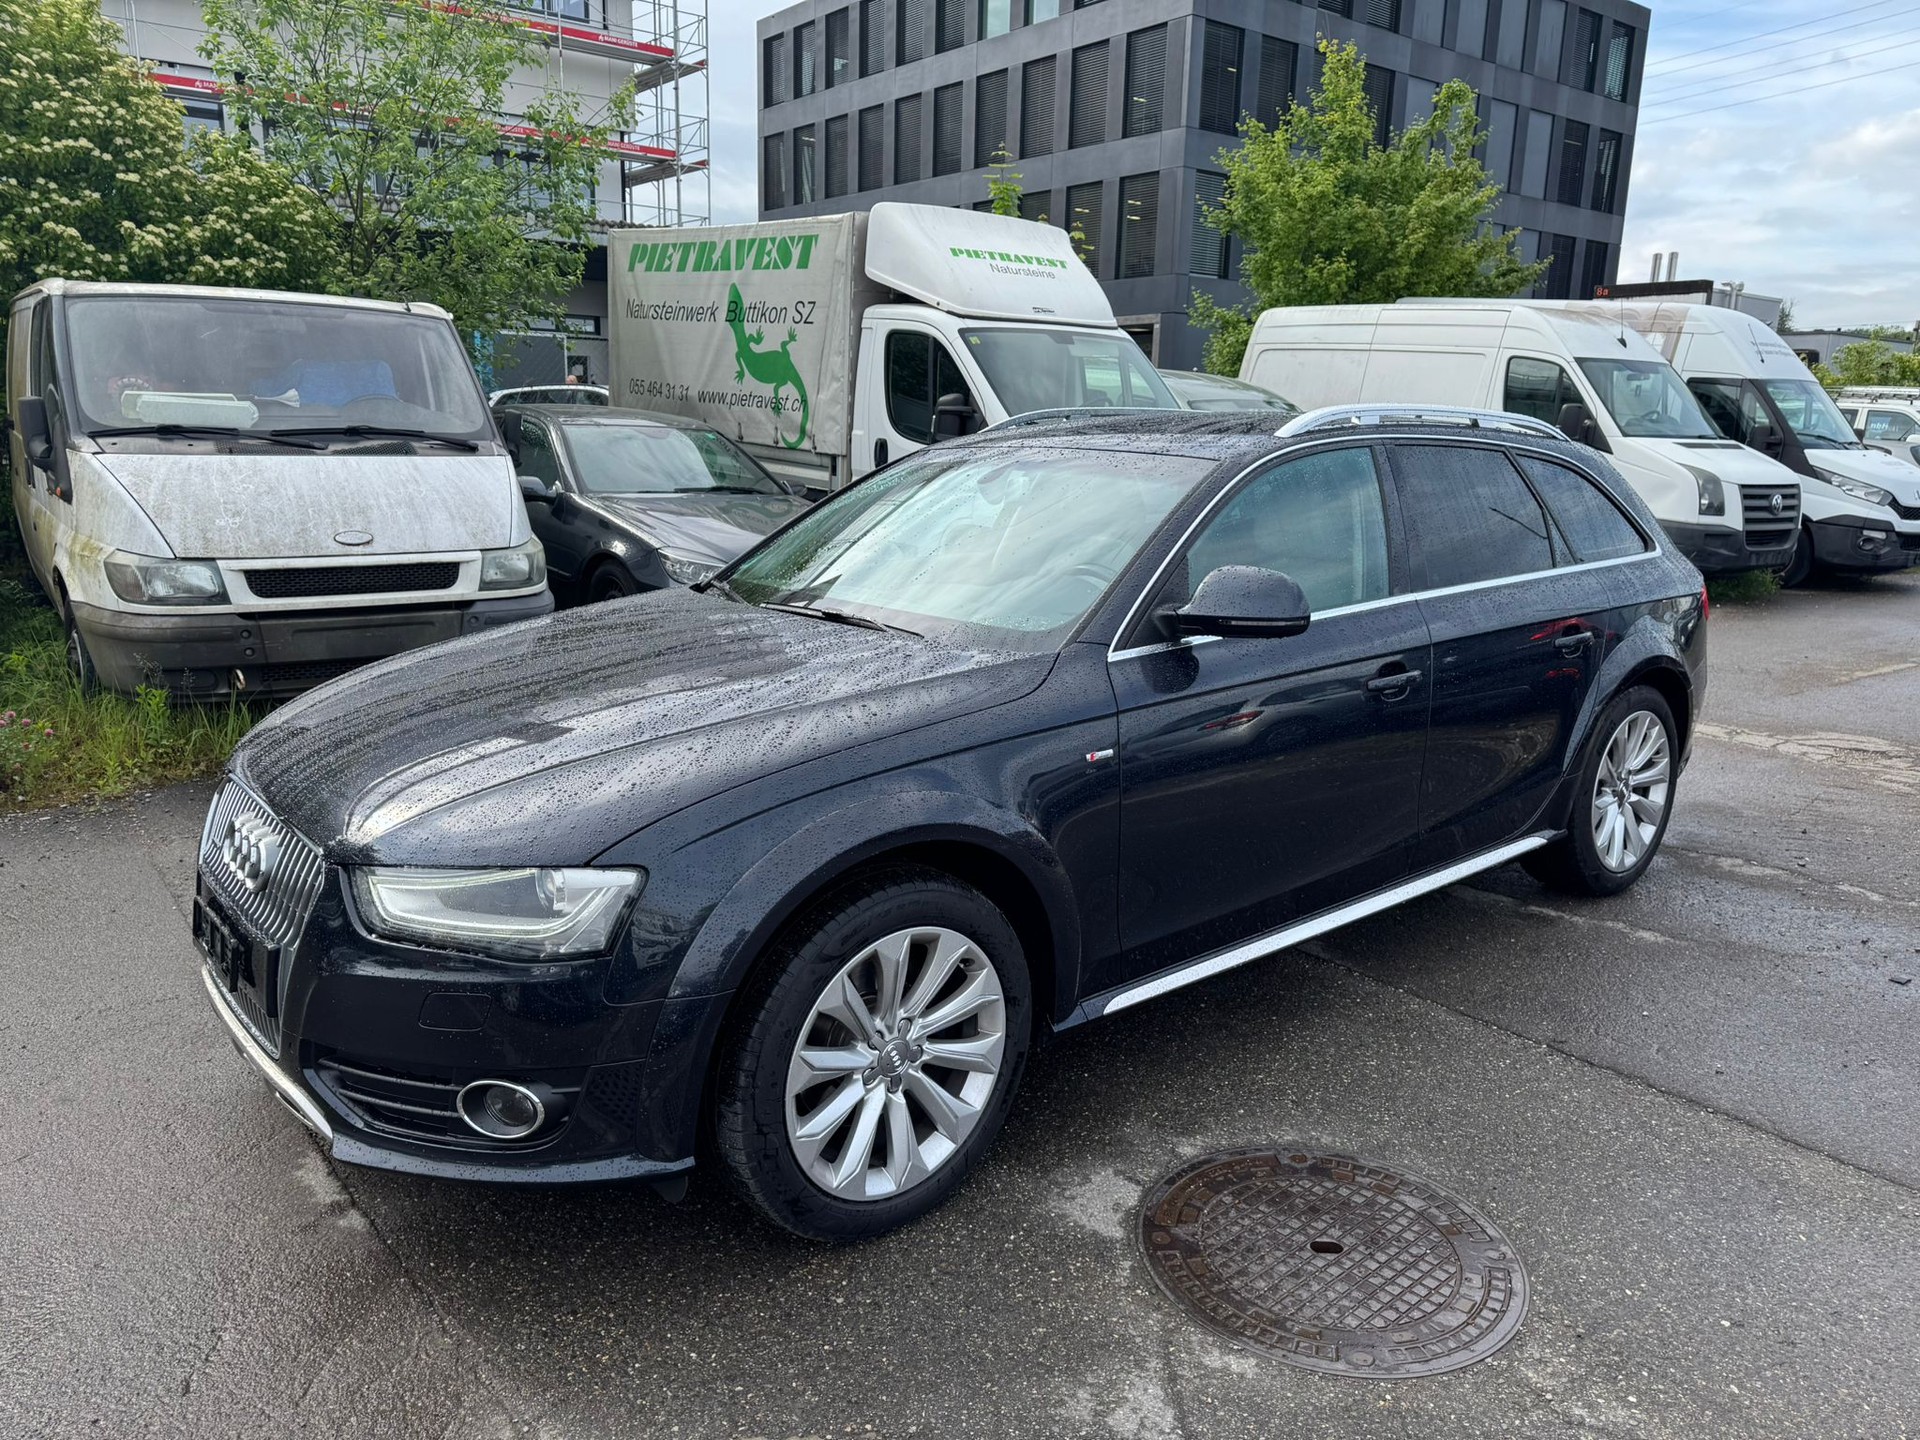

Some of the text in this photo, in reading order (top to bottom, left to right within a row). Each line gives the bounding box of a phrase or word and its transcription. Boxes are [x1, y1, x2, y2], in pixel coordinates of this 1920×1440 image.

[628, 234, 819, 272] PIETRAVEST
[949, 247, 1067, 269] PIETRAVEST
[989, 263, 1056, 279] Natursteine
[626, 298, 816, 325] Natursteinwerk Buttikon SZ
[629, 378, 807, 413] 055 464 31 31 www.pietravest.ch
